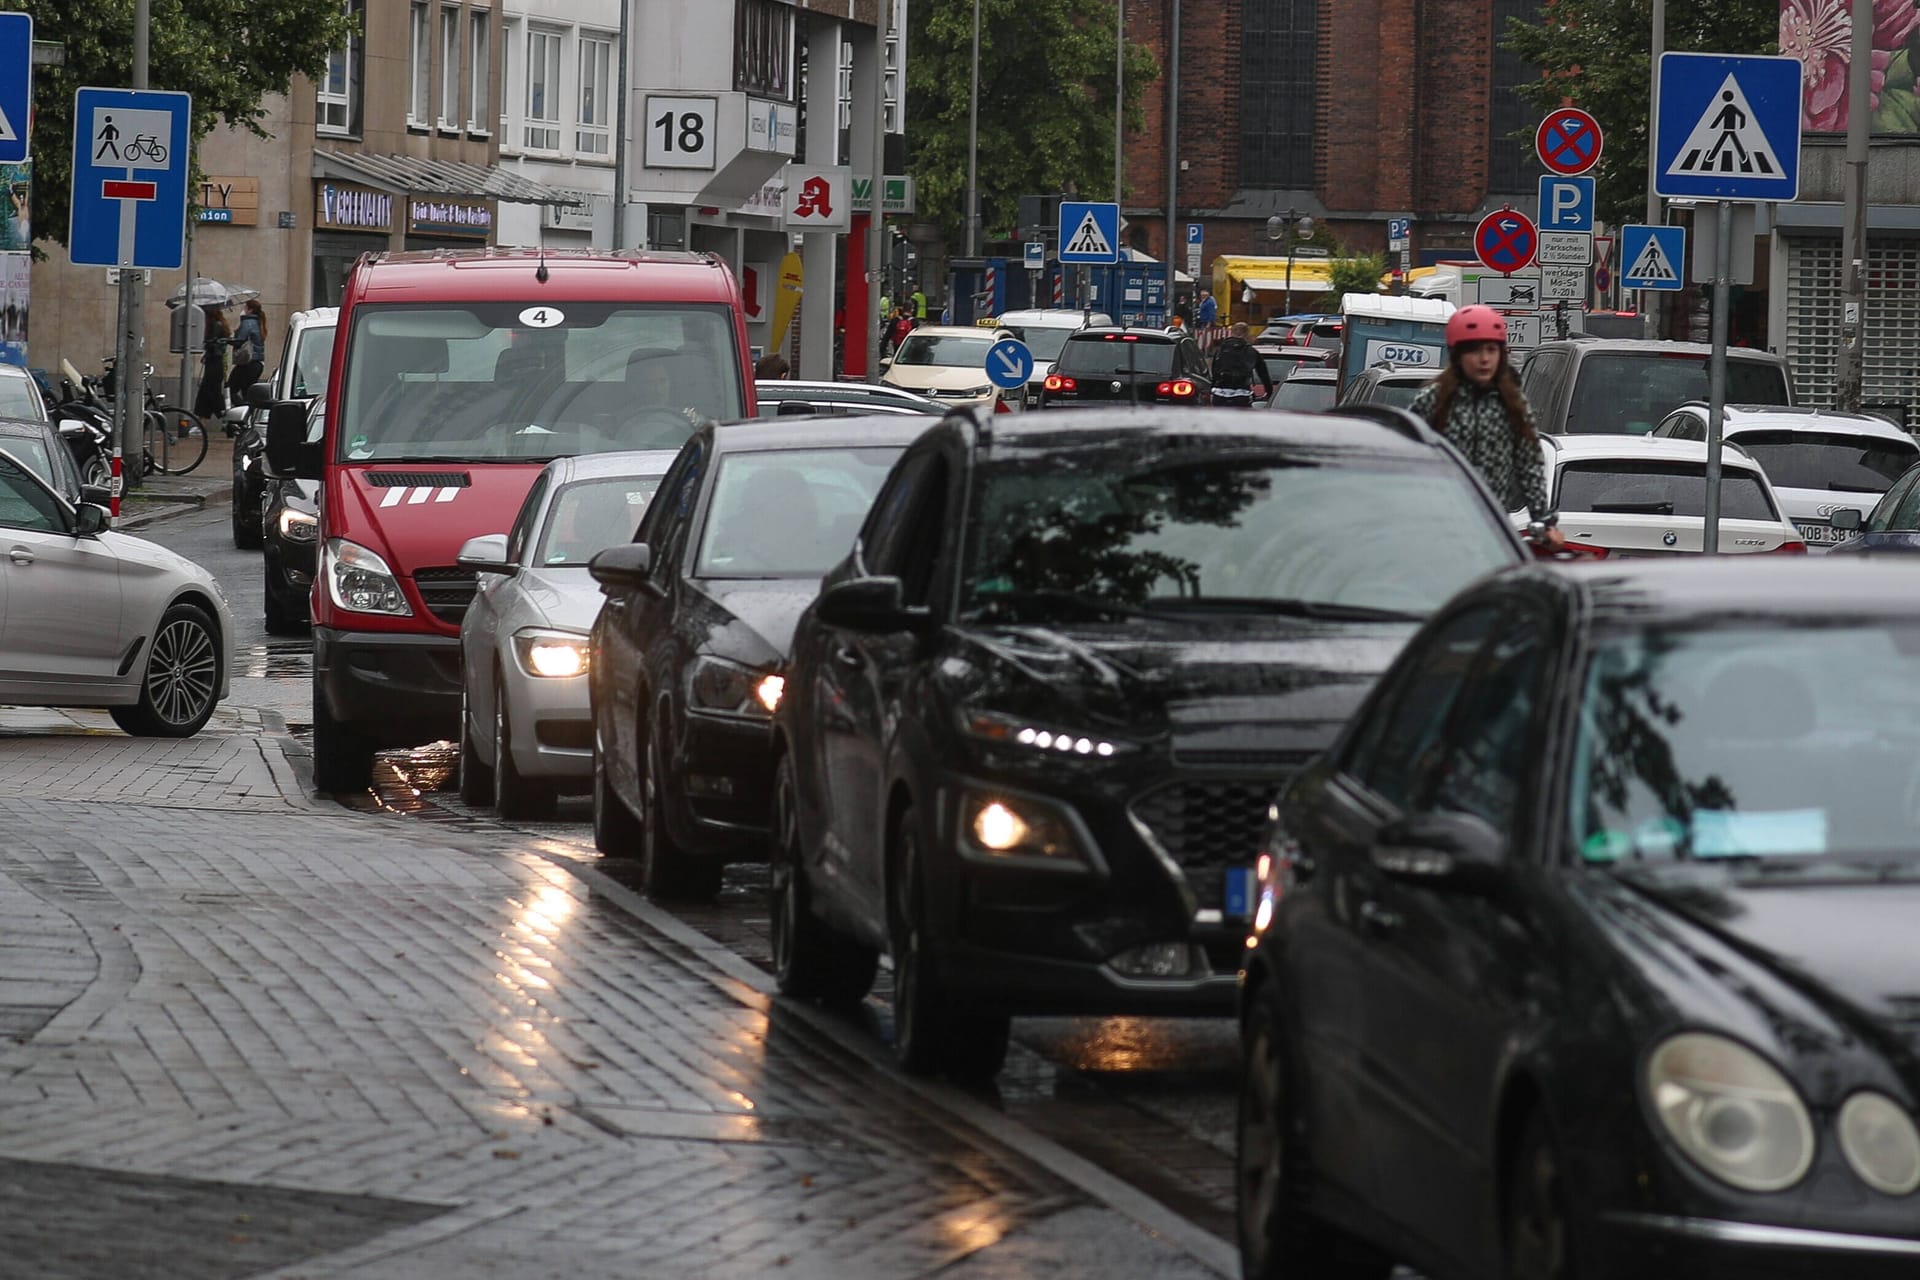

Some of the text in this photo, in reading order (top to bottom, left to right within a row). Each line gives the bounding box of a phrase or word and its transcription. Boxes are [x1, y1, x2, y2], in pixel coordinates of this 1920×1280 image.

[655, 111, 704, 153] 18
[201, 182, 233, 207] TY
[1552, 183, 1582, 225] P
[1189, 226, 1199, 241] P
[1545, 243, 1585, 252] Parkschein
[1557, 252, 1586, 260] Stunden
[1550, 279, 1577, 287] Mo-Sa
[533, 310, 548, 324] 4
